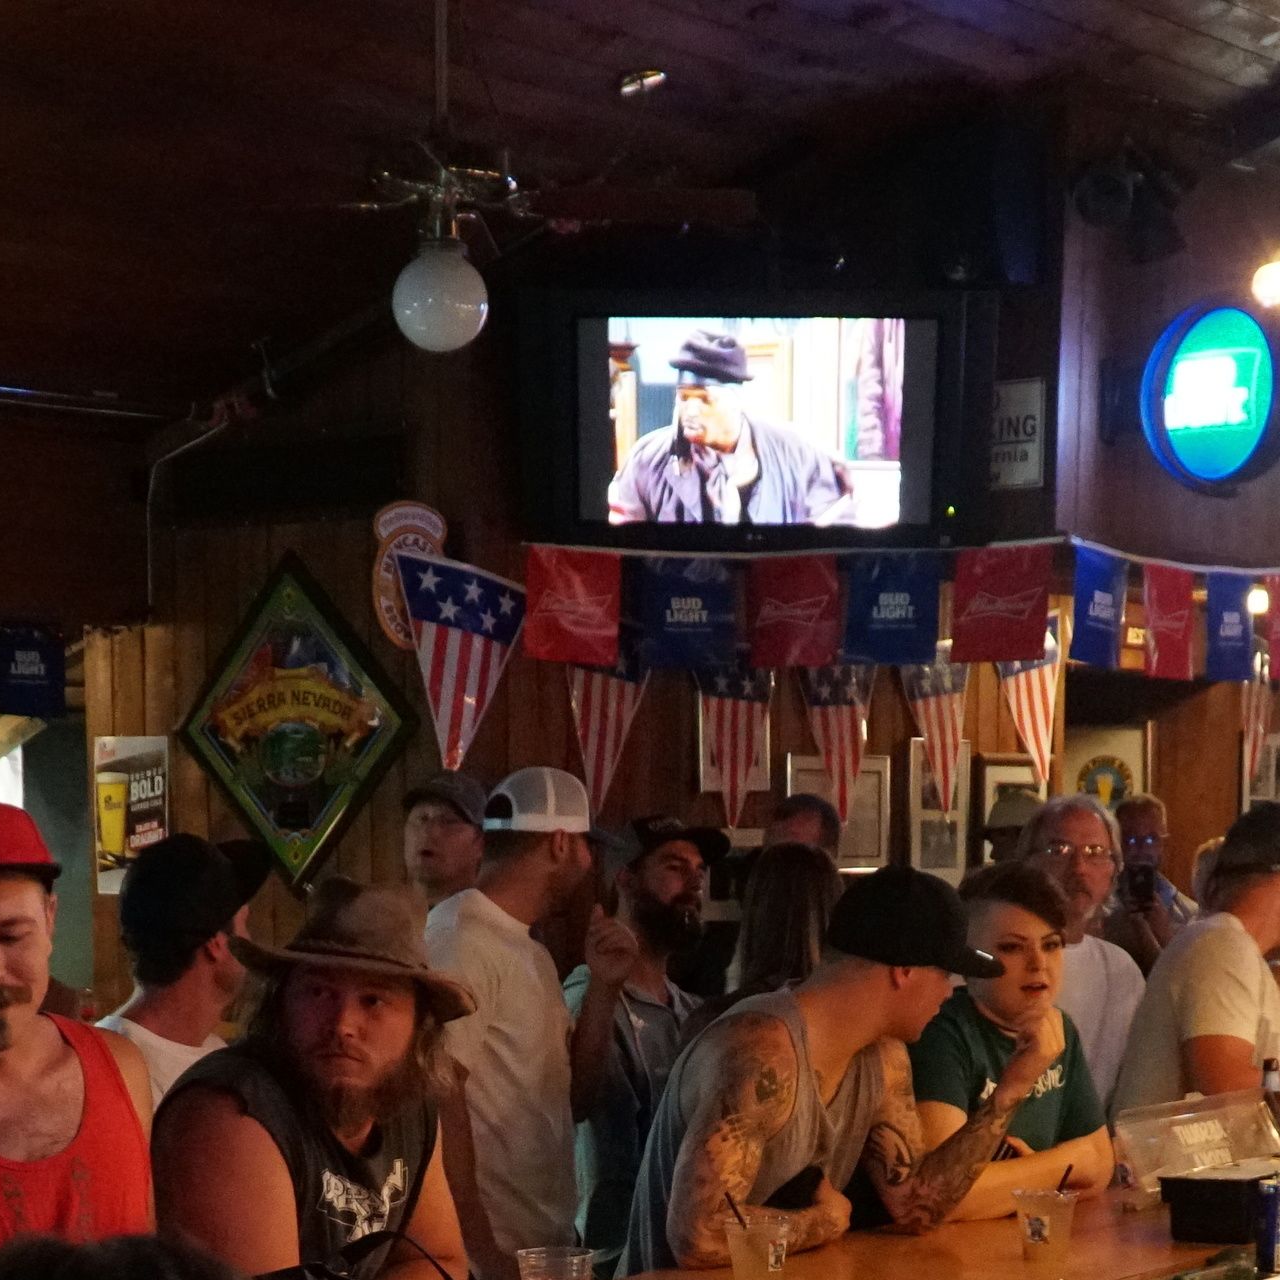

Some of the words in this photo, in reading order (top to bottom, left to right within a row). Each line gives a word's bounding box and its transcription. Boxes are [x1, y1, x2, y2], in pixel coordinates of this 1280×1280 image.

[670, 596, 703, 609] BUD
[878, 592, 911, 606] BUD
[665, 609, 708, 623] LIGHT
[872, 605, 915, 619] LIGHT
[9, 661, 47, 676] LIGHT
[231, 690, 287, 725] SIERRA
[290, 688, 353, 721] NEVADA
[130, 775, 163, 802] BOLD
